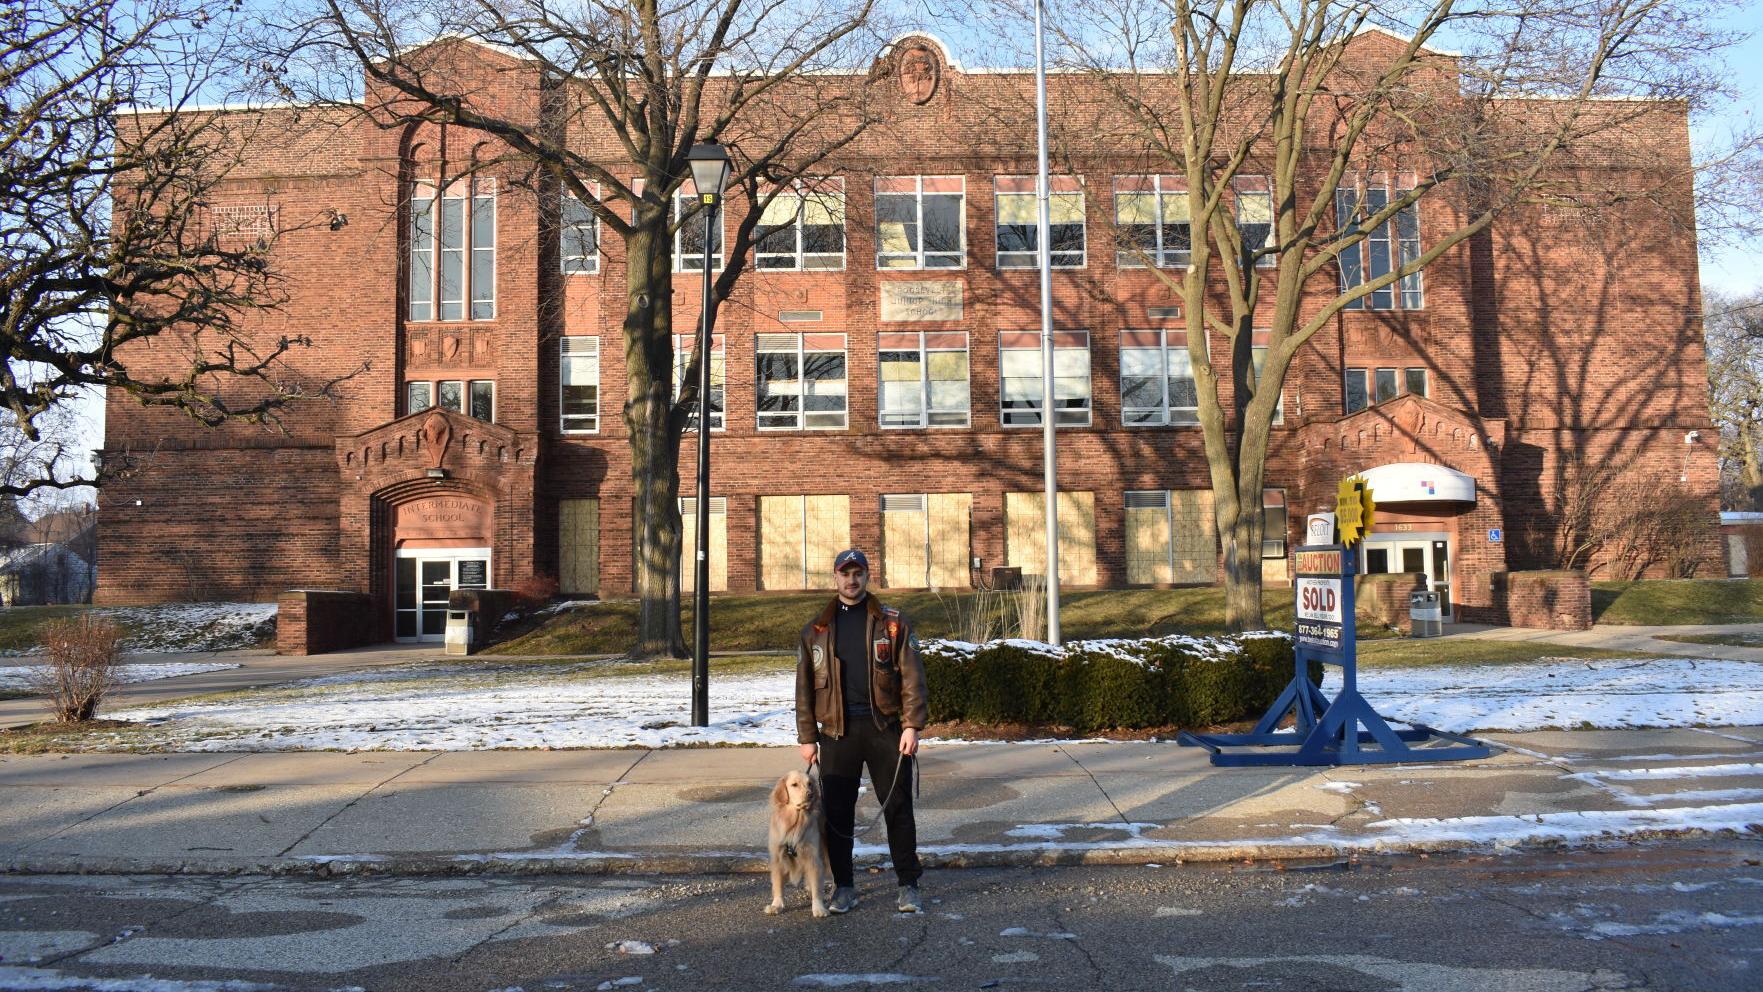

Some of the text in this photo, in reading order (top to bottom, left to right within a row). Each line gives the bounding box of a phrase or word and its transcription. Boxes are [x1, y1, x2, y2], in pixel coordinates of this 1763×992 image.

[402, 499, 482, 515] INTERMEDIATE
[422, 511, 465, 523] SCHOOL
[1303, 553, 1340, 572] AUCTION
[1302, 586, 1336, 612] SOLD
